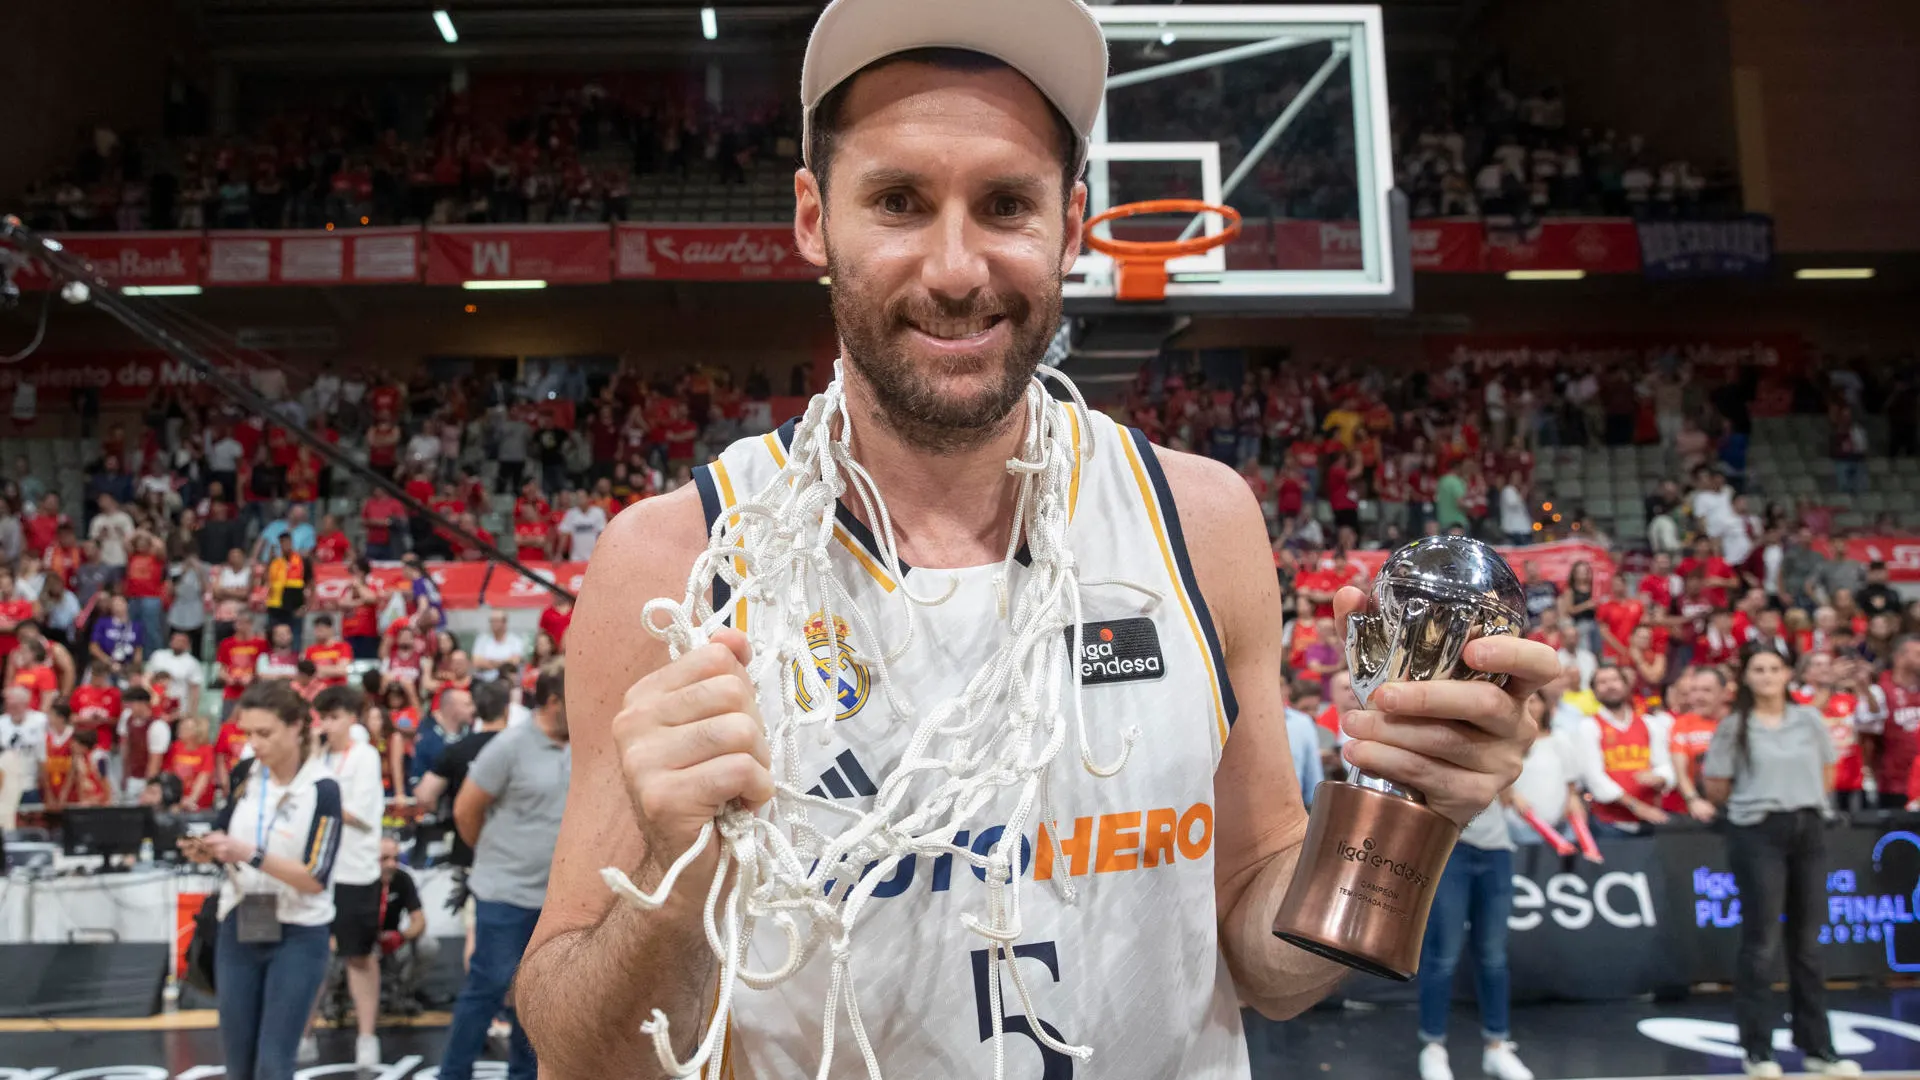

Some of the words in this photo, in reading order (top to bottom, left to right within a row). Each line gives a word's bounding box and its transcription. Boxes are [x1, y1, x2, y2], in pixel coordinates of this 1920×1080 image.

[115, 361, 154, 387] de
[1080, 641, 1113, 660] iga
[1081, 656, 1160, 676] endesa
[1336, 840, 1369, 862] liga
[1370, 852, 1430, 888] endesa
[1827, 894, 1914, 925] FINAL
[970, 940, 1074, 1080] 5
